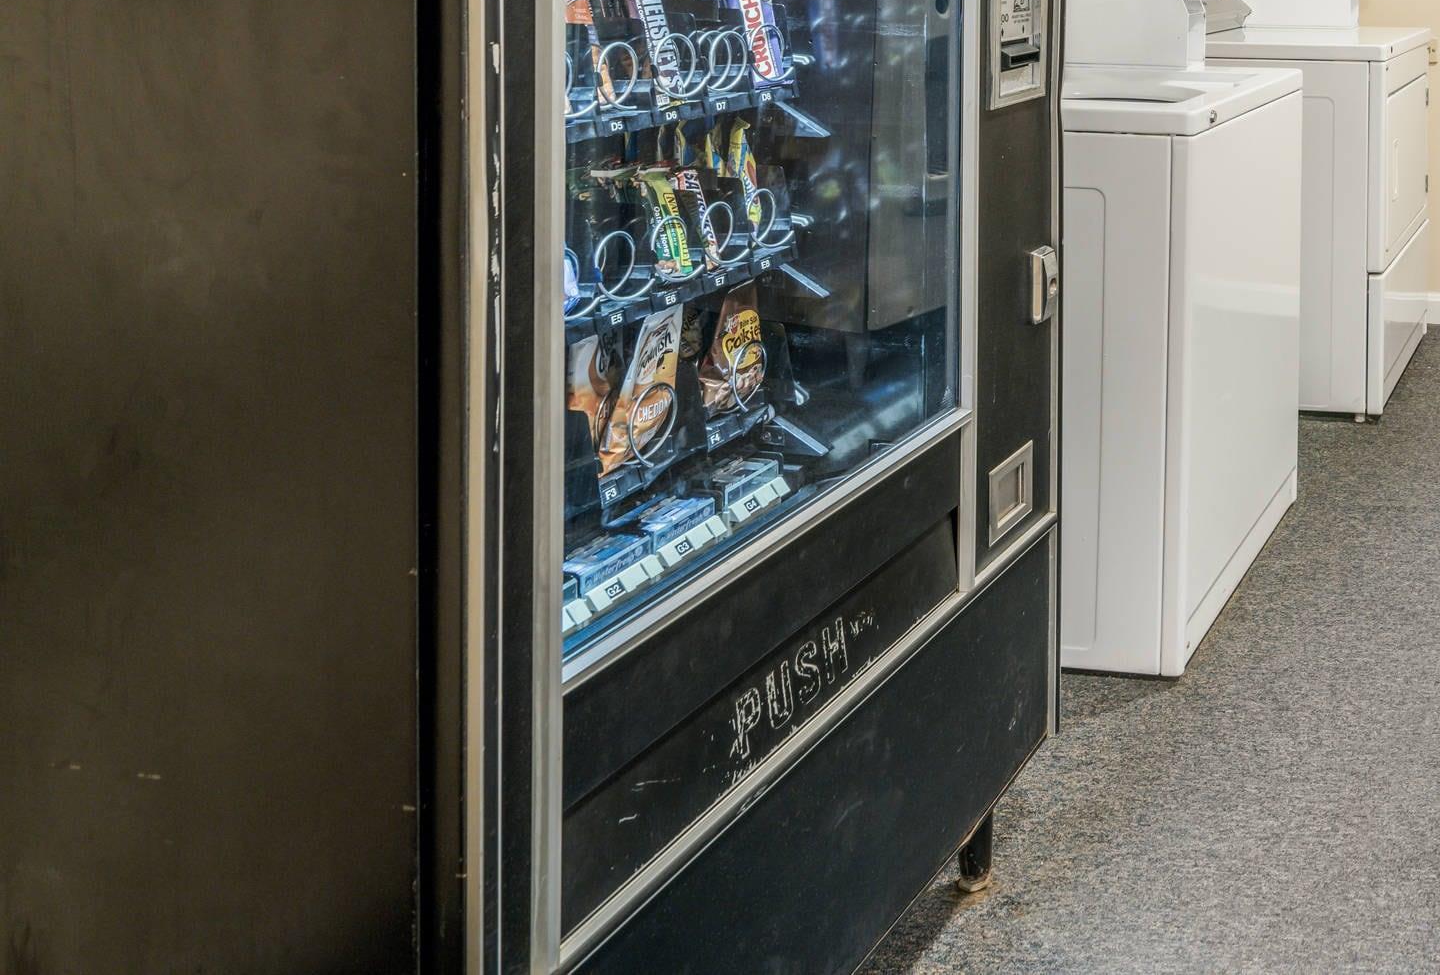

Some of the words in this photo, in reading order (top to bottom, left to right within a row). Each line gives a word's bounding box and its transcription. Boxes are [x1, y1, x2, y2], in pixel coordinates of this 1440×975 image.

[761, 92, 771, 101] D8
[716, 101, 726, 111] D7
[665, 110, 678, 120] D6
[611, 121, 623, 132] D5
[661, 232, 670, 258] Honey
[761, 260, 771, 269] E8
[715, 276, 725, 286] E7
[665, 294, 677, 305] E6
[611, 313, 623, 325] E5
[637, 396, 672, 422] CHEDDA
[710, 434, 721, 445] F4
[605, 487, 617, 500] F3
[744, 498, 758, 510] G4
[676, 541, 690, 554] G3
[607, 584, 622, 598] G2
[735, 616, 848, 759] PUSH
